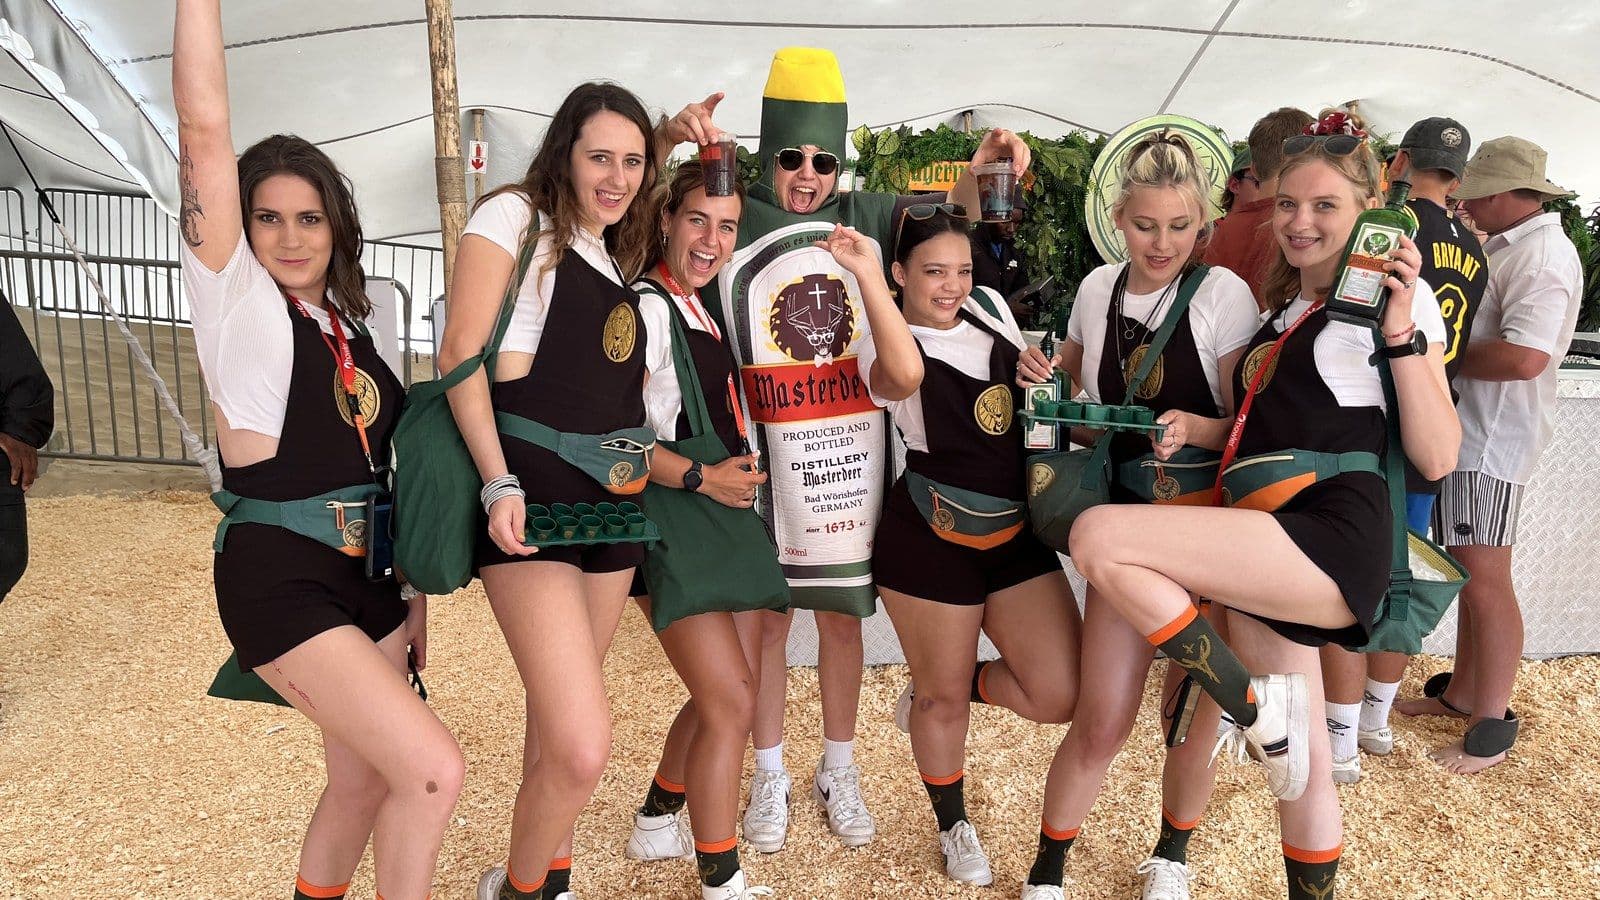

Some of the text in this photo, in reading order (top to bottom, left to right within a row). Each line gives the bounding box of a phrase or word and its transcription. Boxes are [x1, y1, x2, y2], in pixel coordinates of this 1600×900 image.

[793, 236, 804, 246] es
[807, 233, 828, 243] wied
[1432, 241, 1481, 282] BRYANT
[753, 367, 869, 417] Masterde
[782, 422, 871, 442] PRODUCED AND
[804, 436, 854, 453] BOTTLED
[791, 452, 870, 471] DISTILLERY
[802, 466, 863, 489] Masterdeer
[804, 487, 868, 504] Bad Wörishofen
[811, 499, 865, 514] GERMANY
[824, 520, 855, 534] 1673
[784, 547, 808, 557] 500ml
